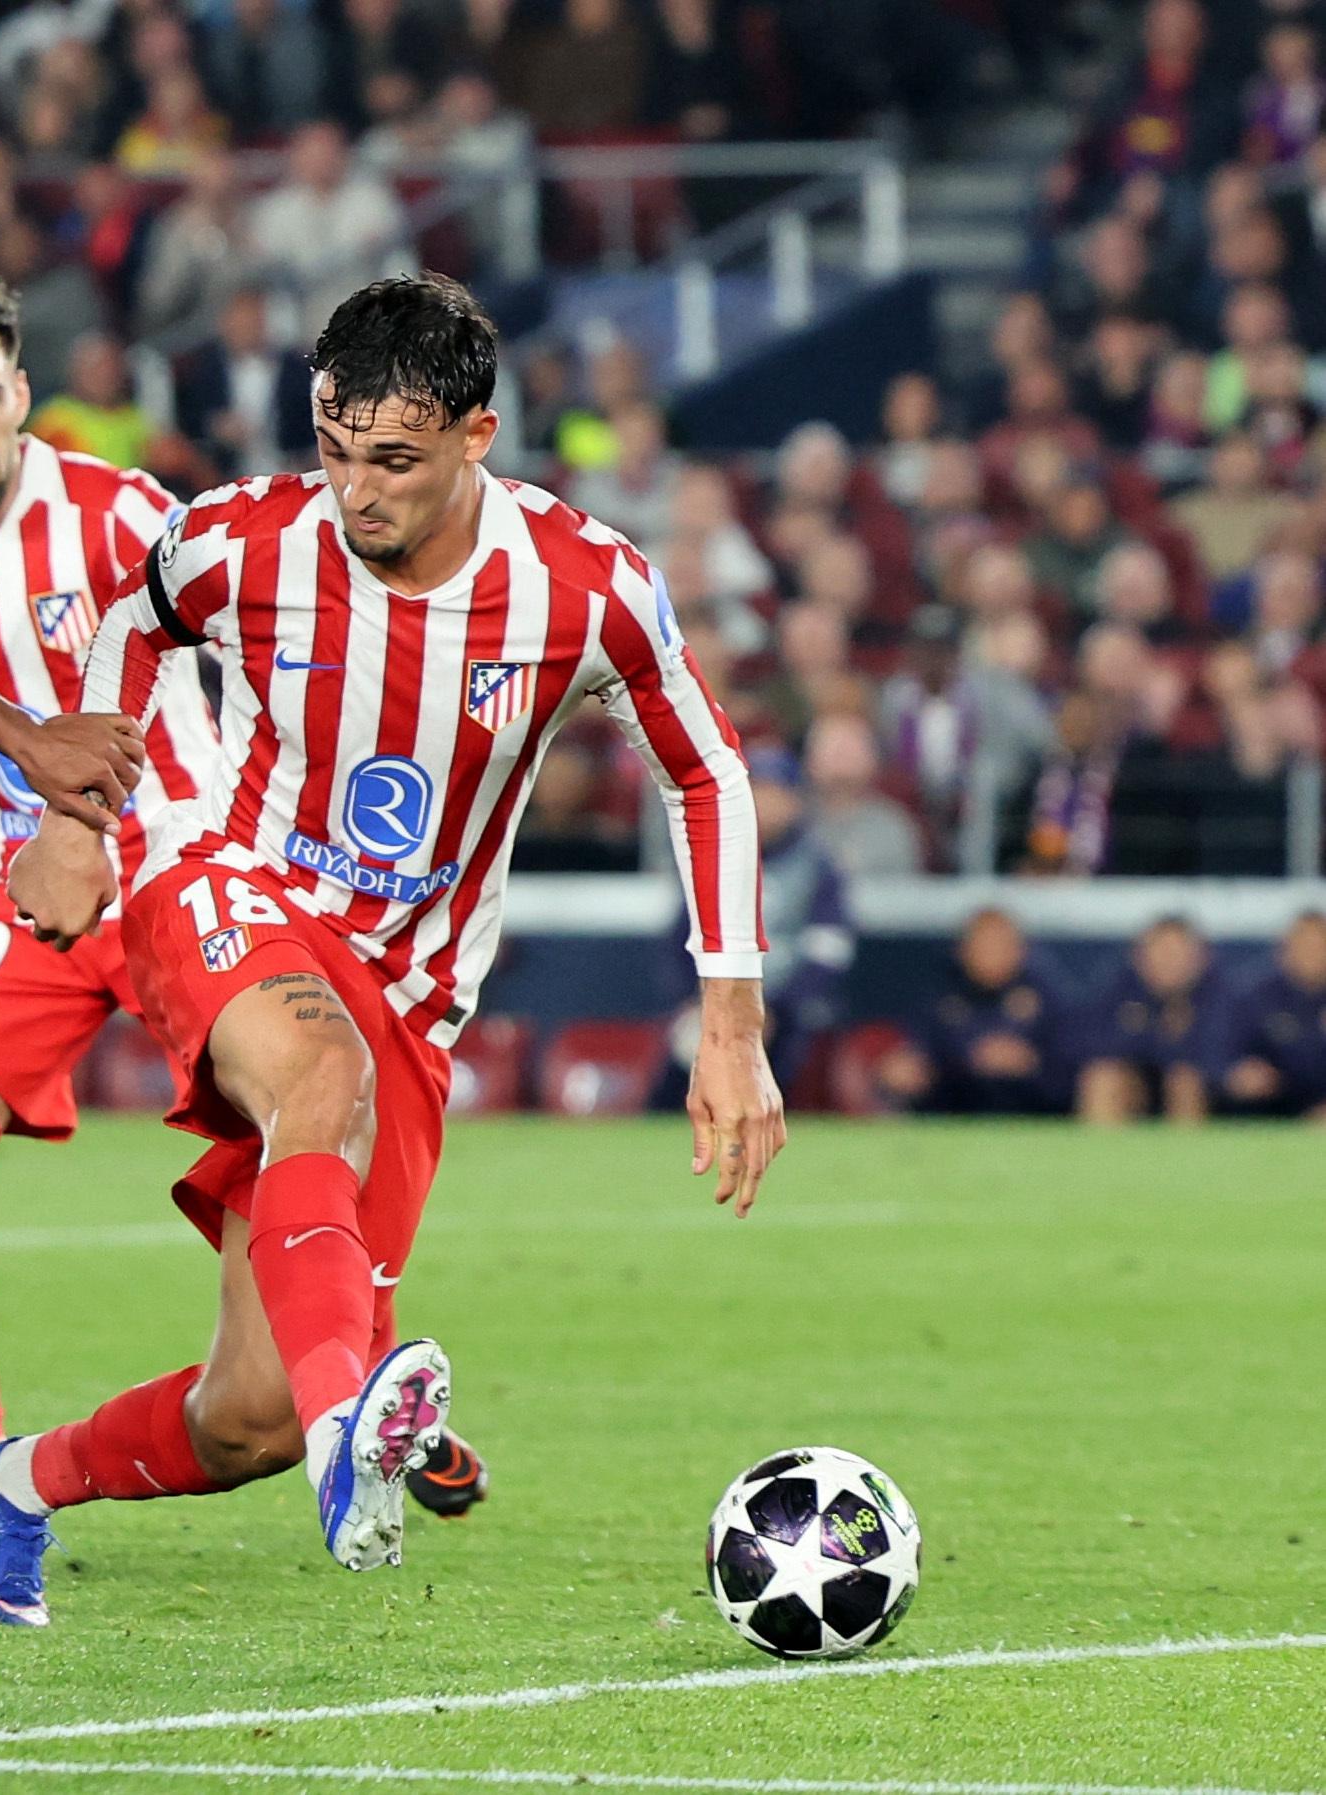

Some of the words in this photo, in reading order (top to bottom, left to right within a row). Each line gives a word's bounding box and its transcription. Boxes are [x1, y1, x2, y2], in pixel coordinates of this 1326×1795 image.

[290, 835, 402, 898] RIYADH
[408, 865, 453, 901] AIR
[178, 875, 289, 938] 18
